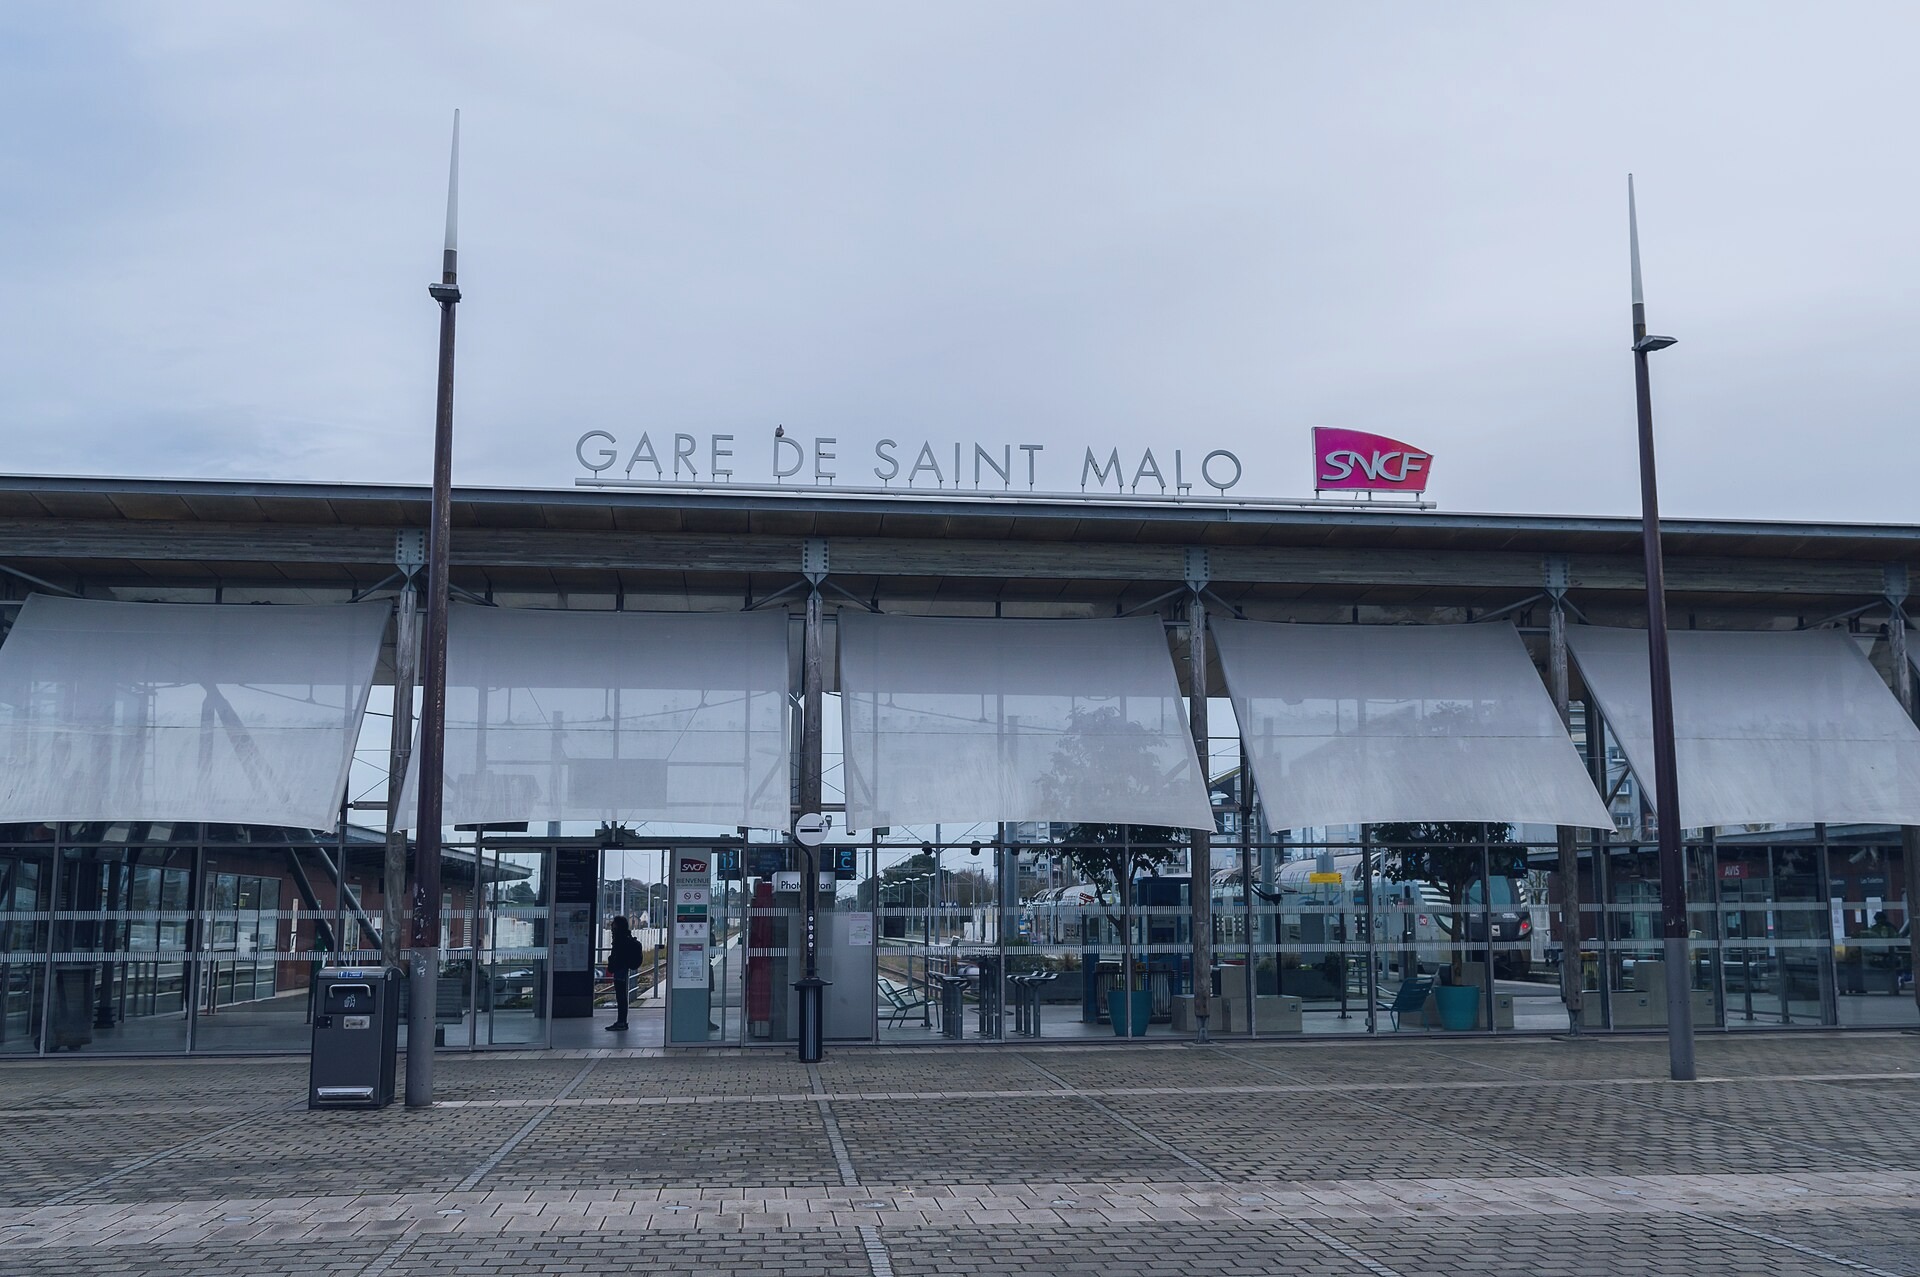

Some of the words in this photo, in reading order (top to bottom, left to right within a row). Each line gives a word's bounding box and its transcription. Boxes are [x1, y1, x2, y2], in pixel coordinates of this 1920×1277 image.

[575, 430, 734, 476] GARE
[772, 437, 837, 478] DE
[873, 438, 1044, 486] SAINT
[1080, 445, 1242, 489] MALO
[1320, 449, 1428, 482] SNCF
[681, 863, 706, 871] SNCF
[841, 857, 851, 868] C
[1724, 865, 1740, 876] AVIS
